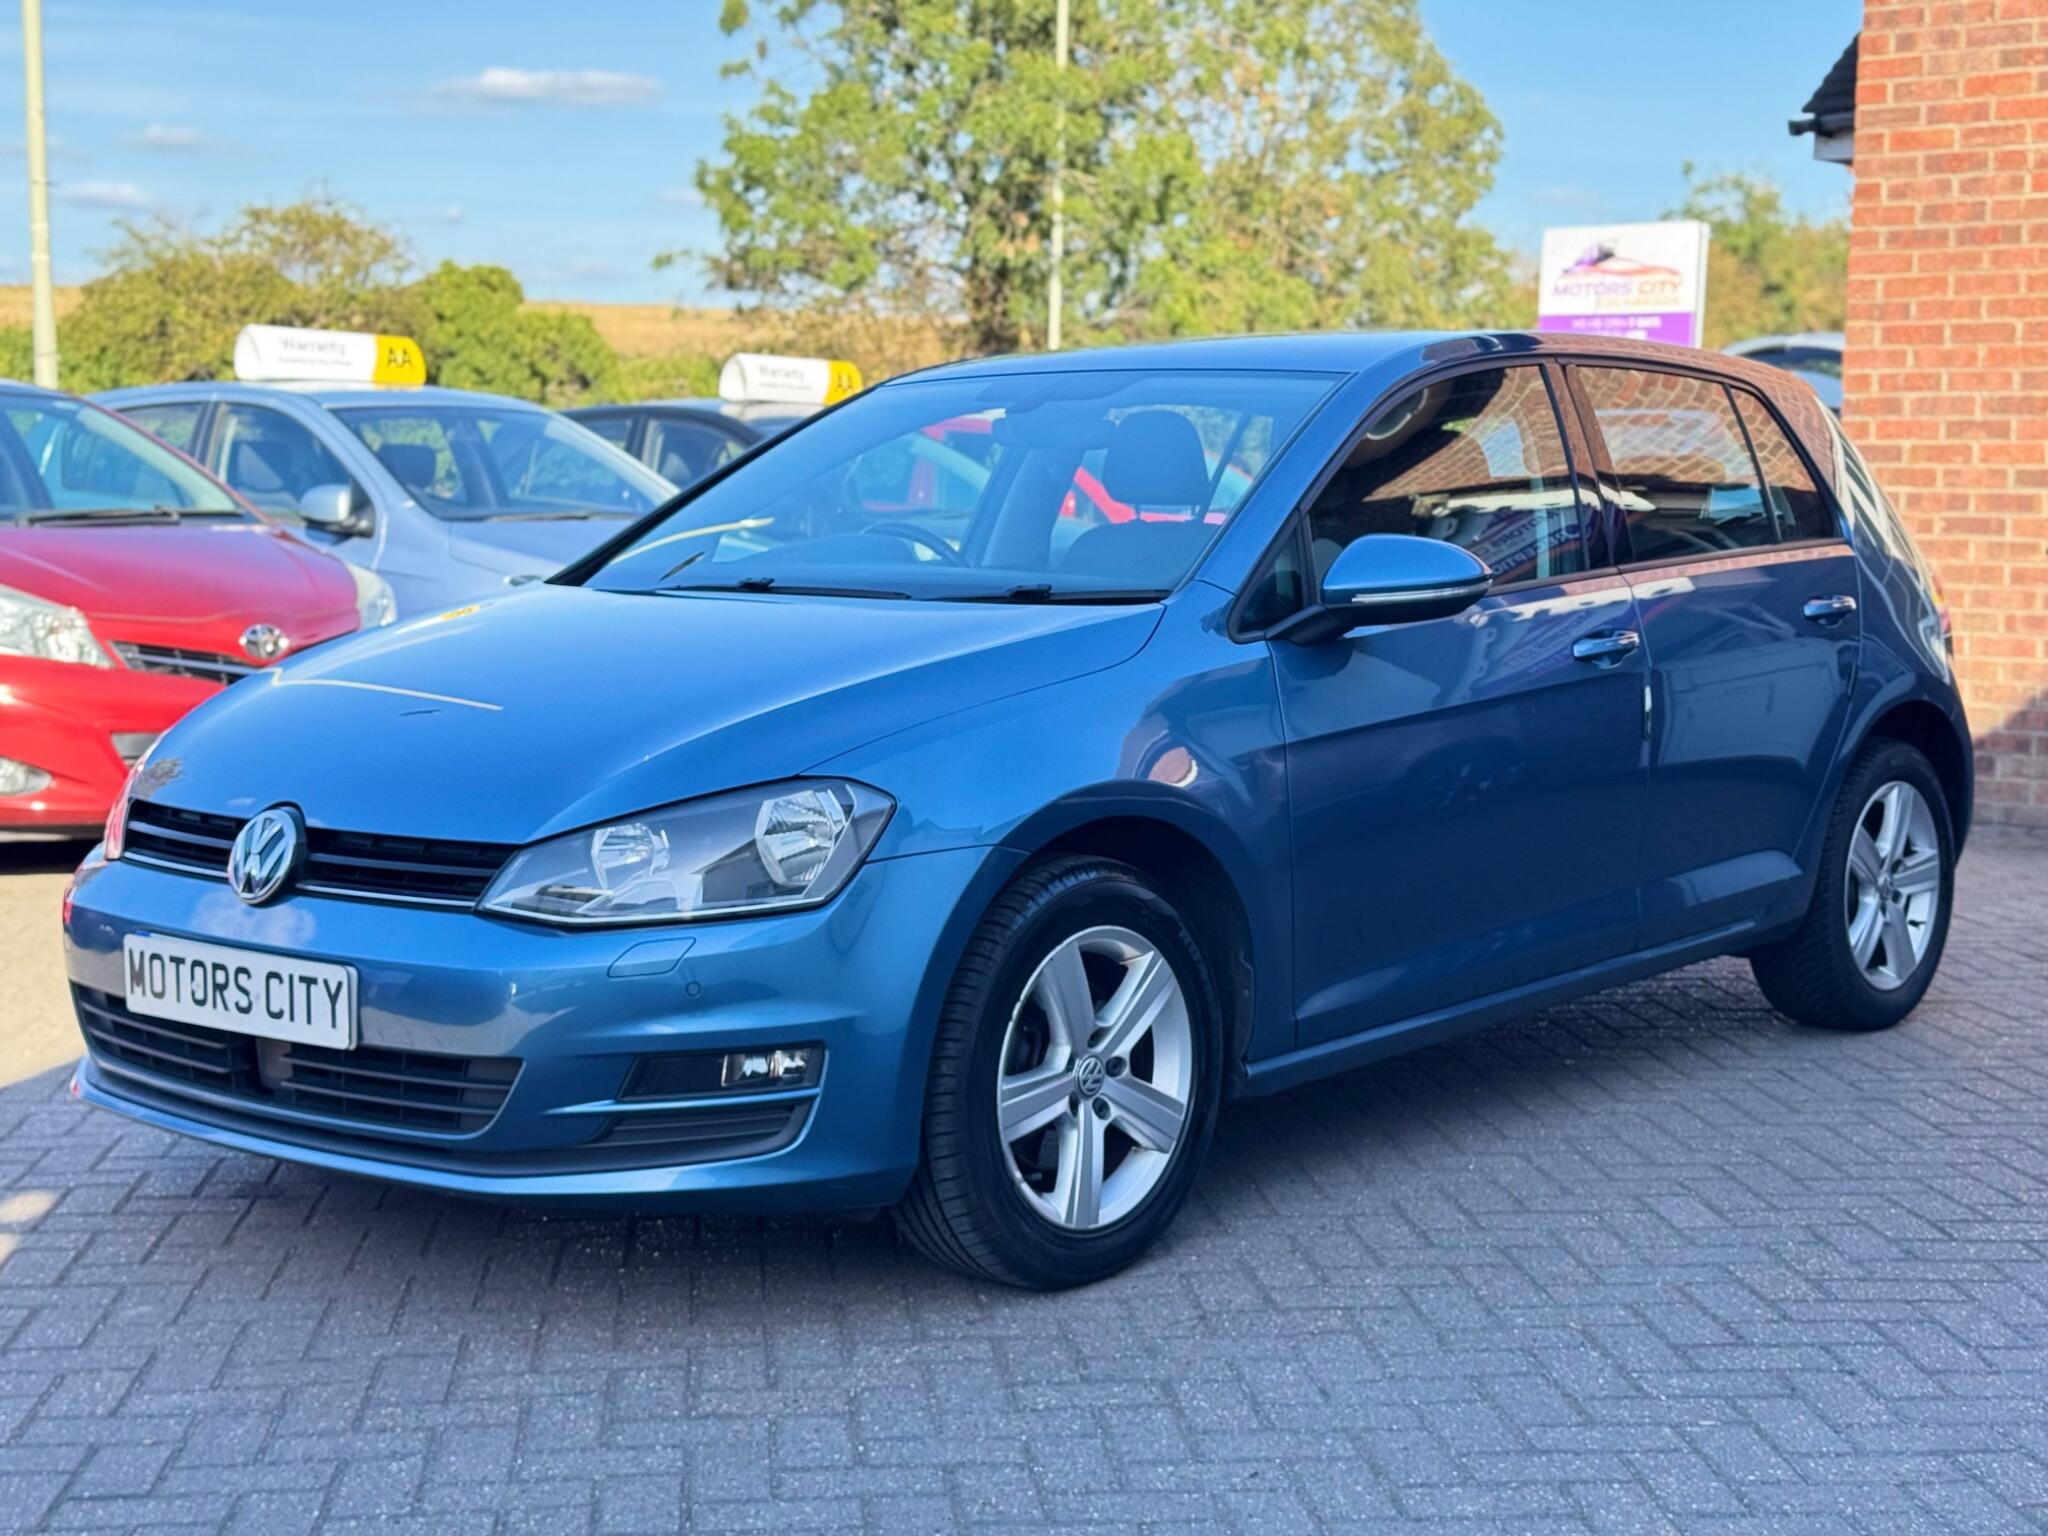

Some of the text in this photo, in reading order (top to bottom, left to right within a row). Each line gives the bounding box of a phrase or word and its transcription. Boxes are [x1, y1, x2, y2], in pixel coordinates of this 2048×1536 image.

[1553, 279, 1681, 296] MOTORS CITY
[386, 346, 413, 369] AA
[128, 947, 343, 1030] MOTORS CITY
